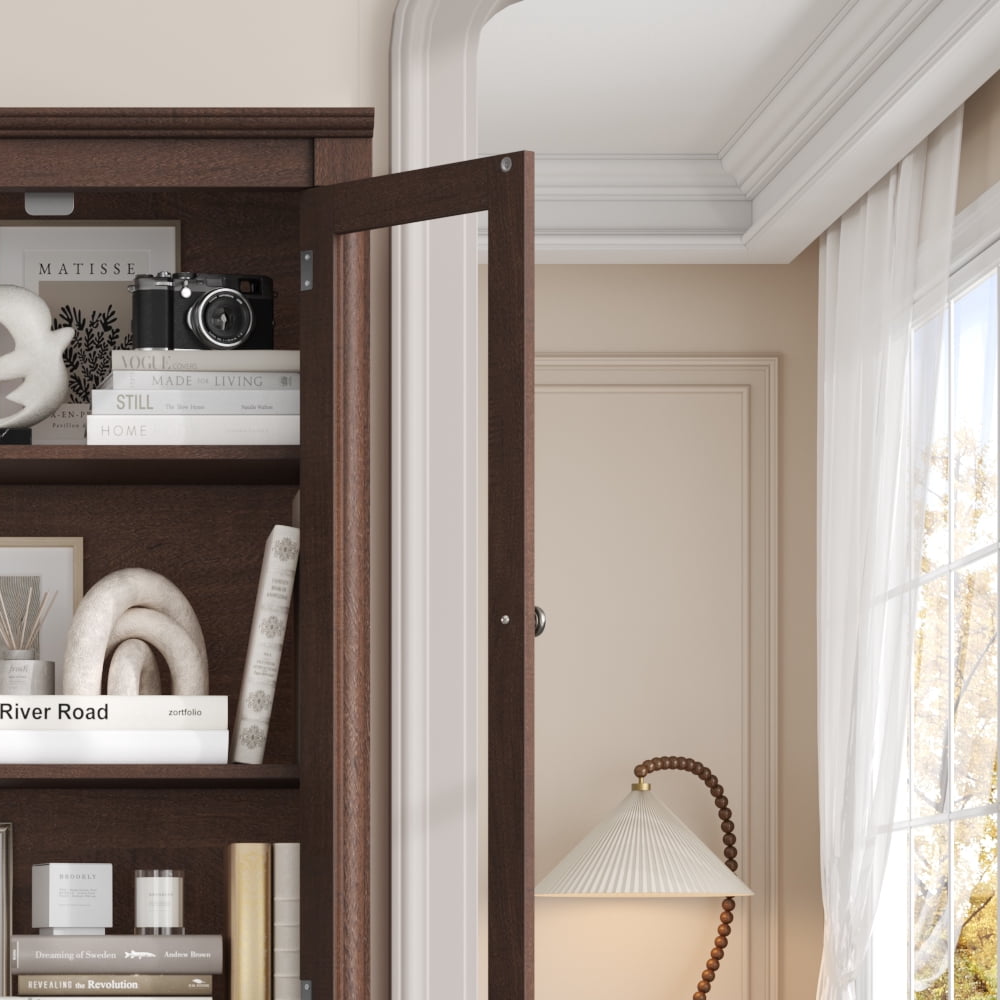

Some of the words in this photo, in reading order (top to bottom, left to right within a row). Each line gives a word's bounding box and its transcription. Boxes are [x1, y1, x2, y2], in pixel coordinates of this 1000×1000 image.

[39, 262, 136, 275] MATISSE
[121, 355, 172, 369] VOGUE
[152, 375, 193, 386] MADE
[215, 375, 265, 387] LIVING
[116, 393, 154, 410] STILL
[101, 425, 147, 437] HOME
[0, 703, 51, 720] River
[58, 703, 108, 720] Road
[168, 708, 202, 716] zortfolio
[35, 951, 74, 960] Dreaming
[75, 951, 84, 959] of
[86, 951, 117, 959] Sweden
[28, 980, 72, 989] REVEALING
[75, 981, 85, 989] the
[87, 979, 138, 989] Revolution
